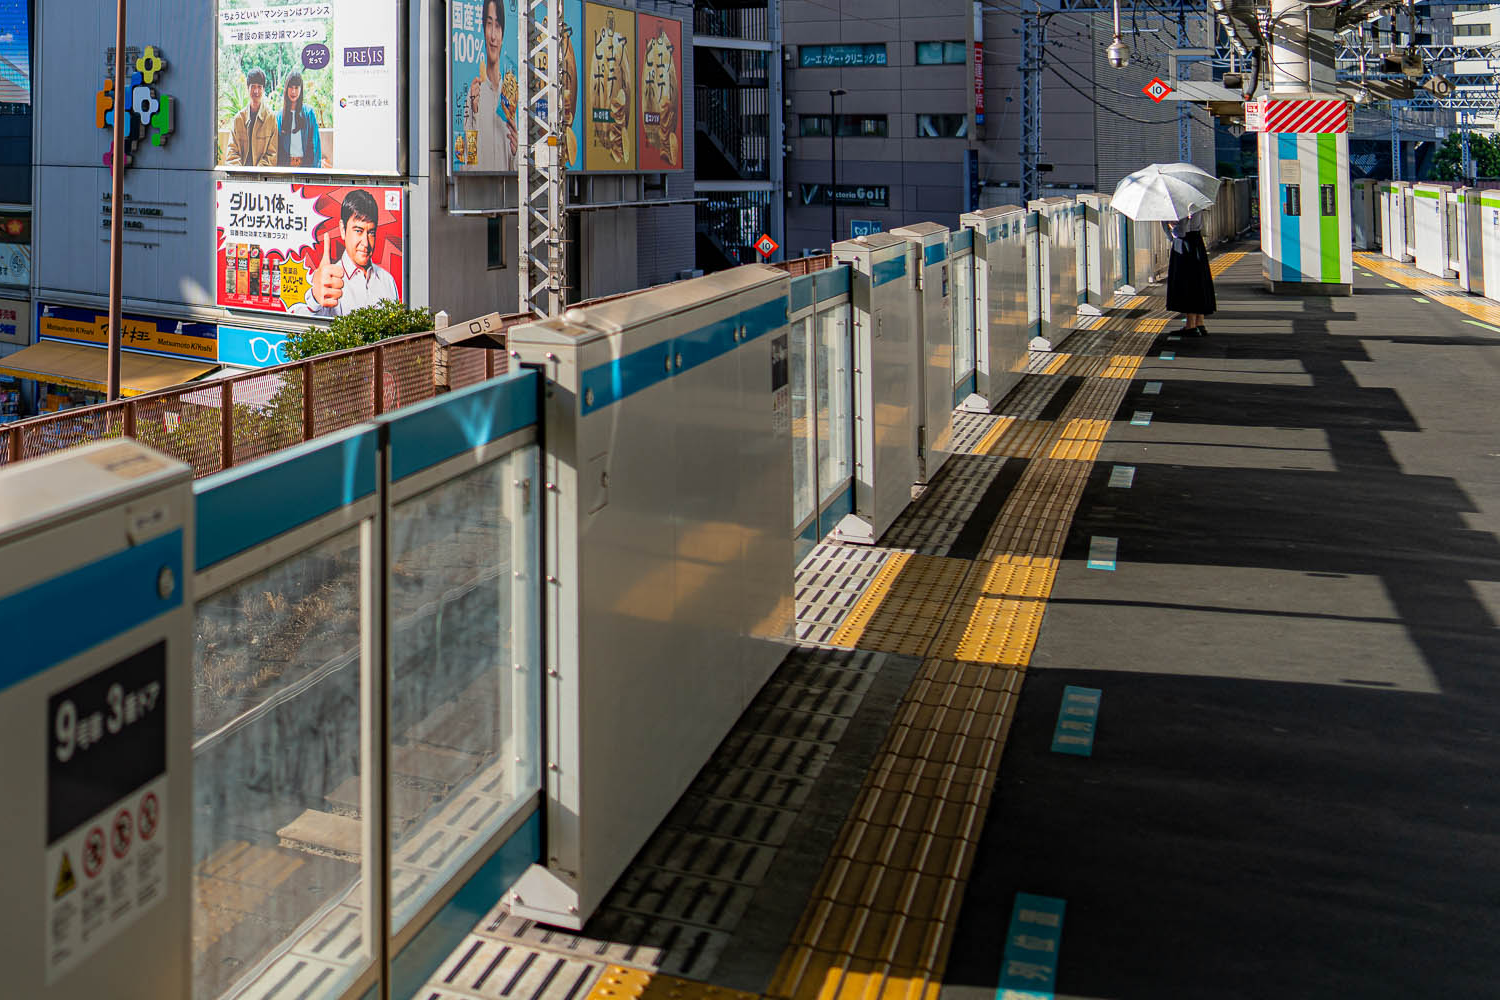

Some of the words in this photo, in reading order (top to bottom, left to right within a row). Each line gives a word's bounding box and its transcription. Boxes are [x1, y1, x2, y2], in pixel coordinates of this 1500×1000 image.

[305, 49, 325, 57] プレシス
[453, 31, 485, 64] 100%
[1152, 86, 1162, 95] 10
[1431, 82, 1448, 95] 10
[827, 190, 856, 199] Vctoria
[857, 187, 886, 200] Golf
[229, 193, 294, 214] ダルい体に
[229, 213, 308, 232] スイッチ入れよう!
[762, 242, 771, 250] 10
[157, 338, 191, 350] Matsumoto
